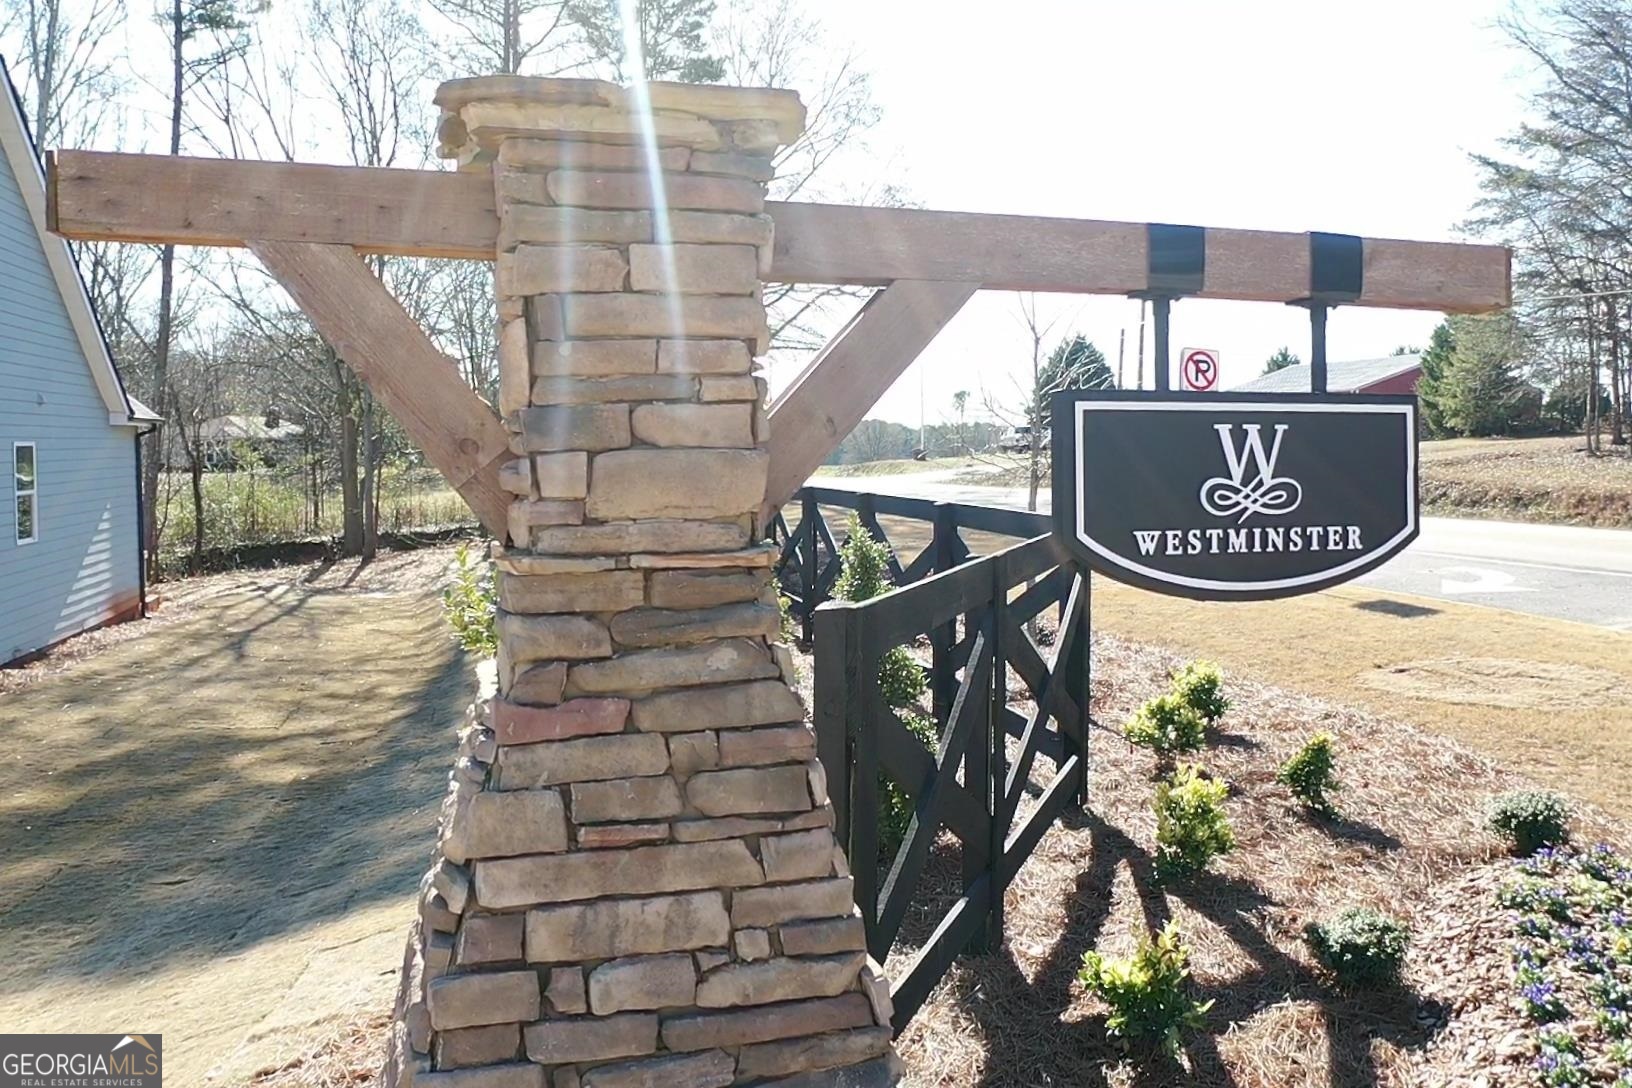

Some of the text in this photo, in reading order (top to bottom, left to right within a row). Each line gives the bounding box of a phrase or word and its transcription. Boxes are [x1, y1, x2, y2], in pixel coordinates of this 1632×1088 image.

[1195, 359, 1211, 382] P
[1213, 423, 1289, 486] W
[1132, 525, 1363, 557] WESTMINSTER
